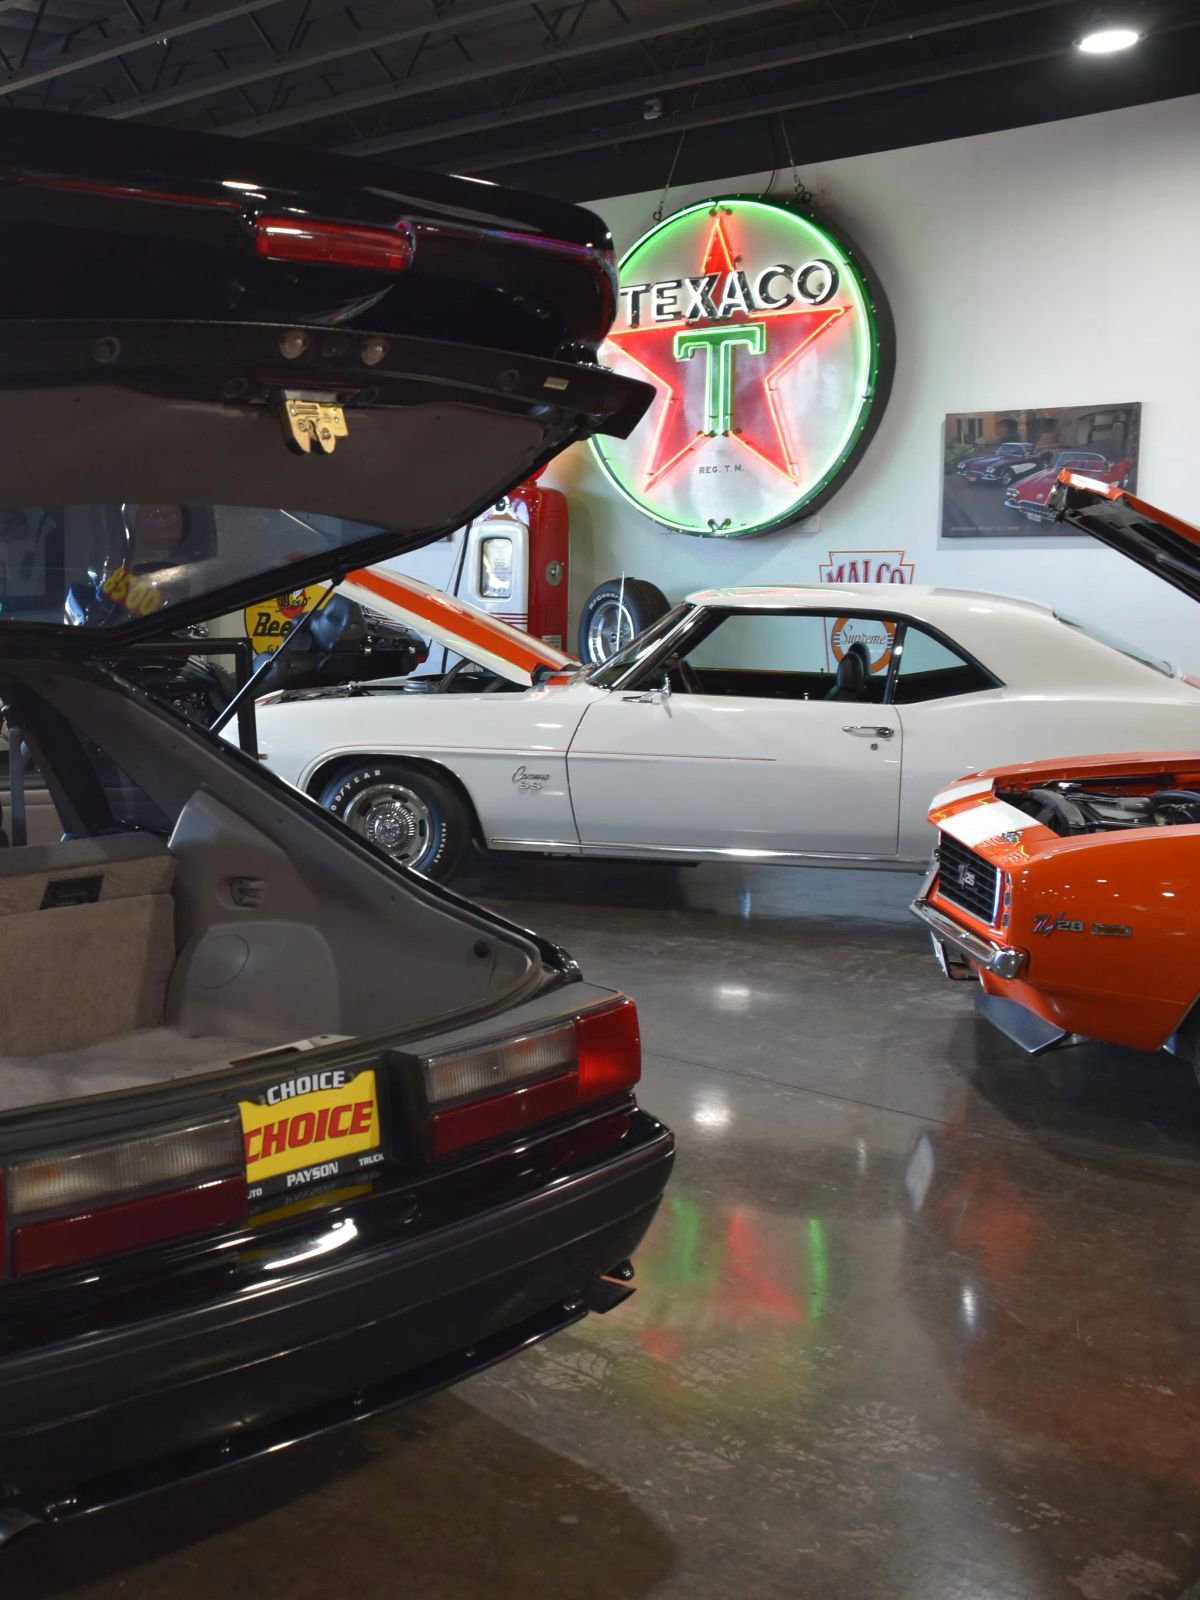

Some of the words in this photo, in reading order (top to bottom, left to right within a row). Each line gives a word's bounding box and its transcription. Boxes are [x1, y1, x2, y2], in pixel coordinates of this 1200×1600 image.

[620, 259, 839, 328] TEXACO
[673, 321, 767, 438] T
[698, 466, 722, 475] REG.
[266, 1070, 346, 1106] CHOICE
[243, 1100, 374, 1165] CHOICE
[286, 1161, 340, 1188] PAYSON
[358, 1153, 385, 1167] TRUCK
